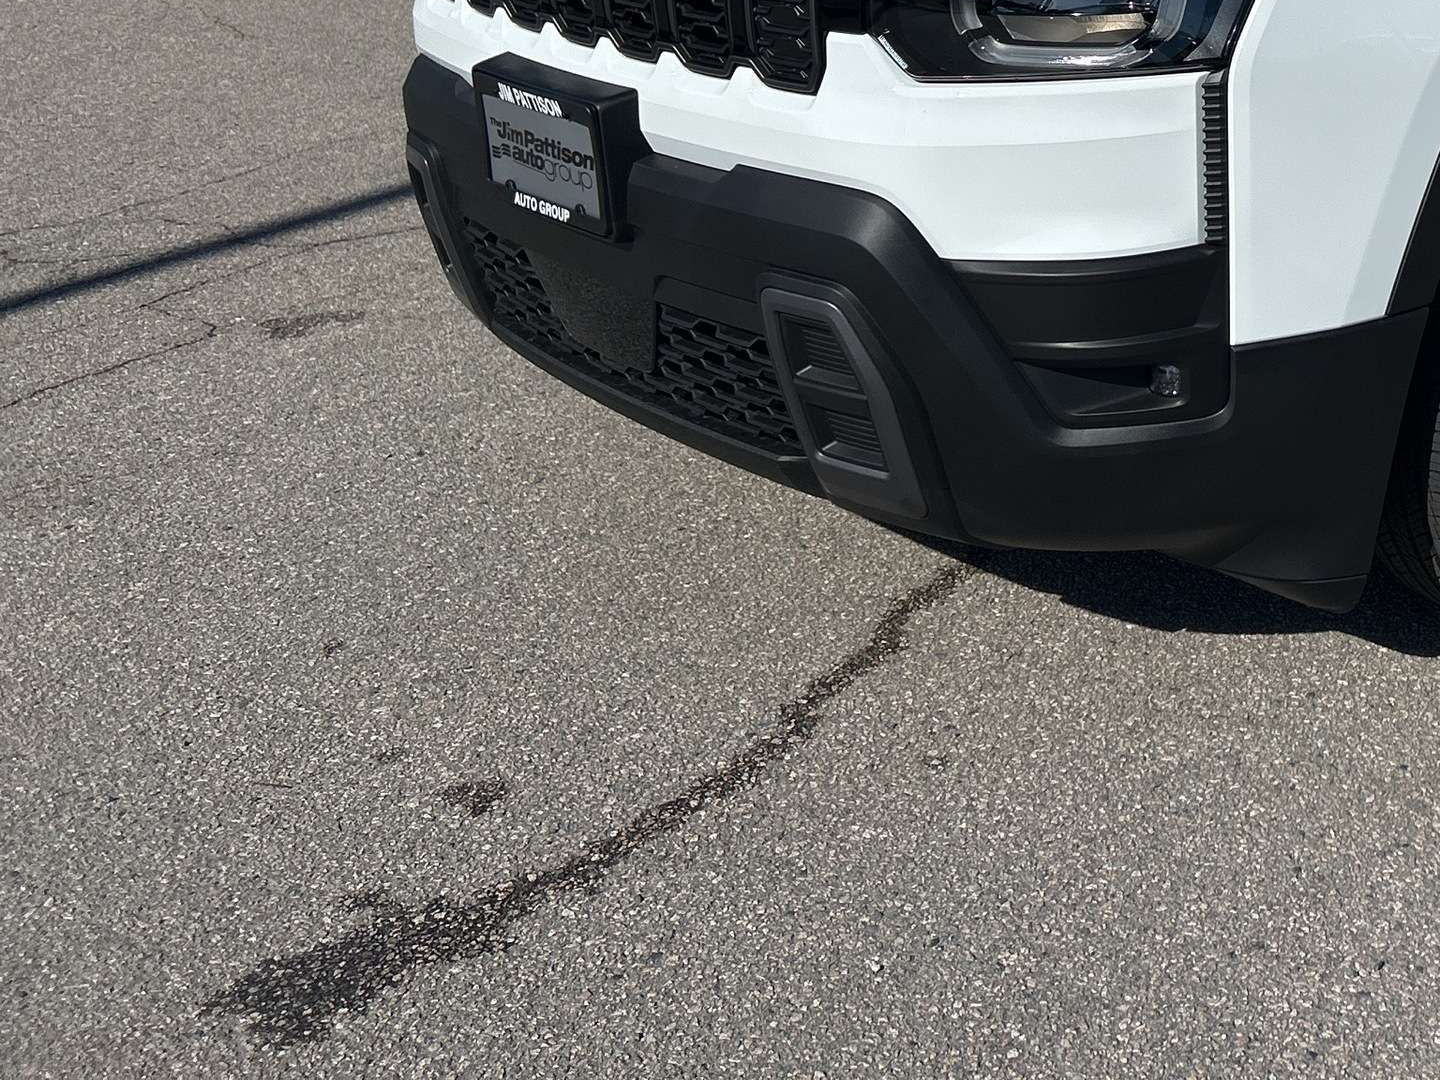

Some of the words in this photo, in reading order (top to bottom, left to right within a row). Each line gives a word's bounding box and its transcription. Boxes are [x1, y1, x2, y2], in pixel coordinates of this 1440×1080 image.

[497, 81, 516, 104] JIM
[512, 87, 563, 118] PATTISON
[513, 191, 538, 212] AUTO
[538, 200, 571, 223] GROUP
